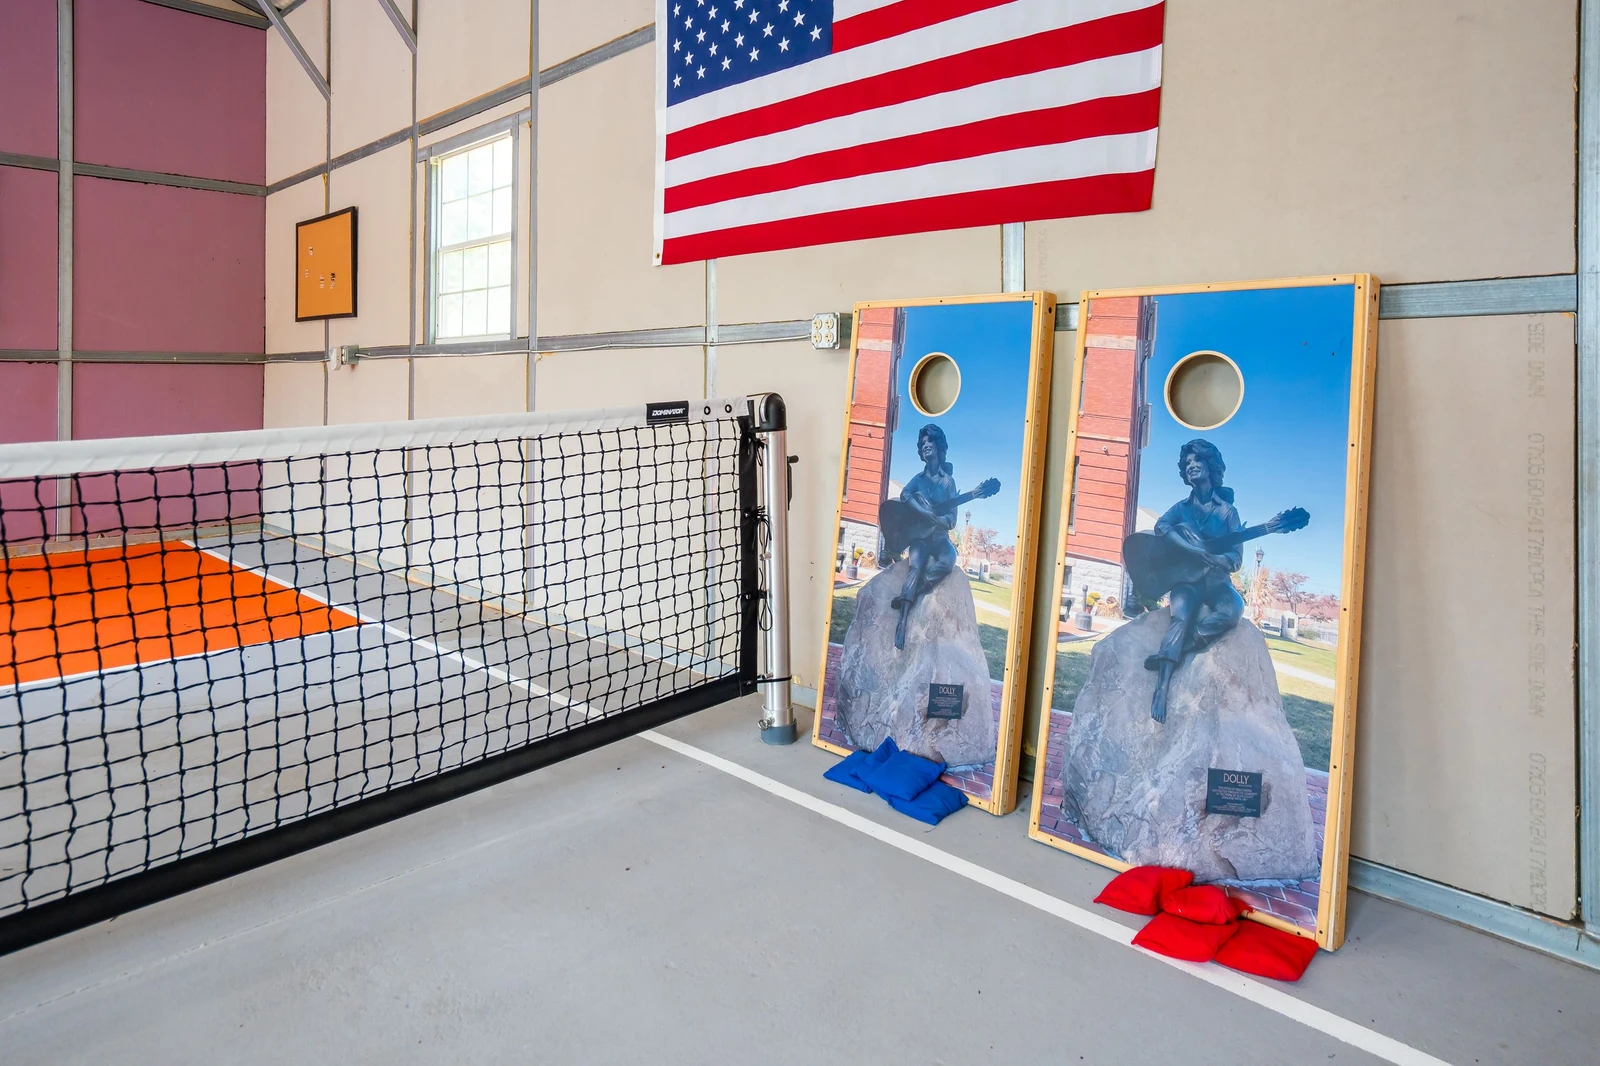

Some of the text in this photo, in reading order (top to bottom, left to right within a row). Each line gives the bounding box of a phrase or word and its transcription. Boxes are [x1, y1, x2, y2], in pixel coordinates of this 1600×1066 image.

[1528, 323, 1545, 354] SIDE
[1528, 360, 1546, 398] DOWN
[652, 408, 685, 416] DOMINATOR
[1528, 605, 1545, 637] THIS
[1528, 643, 1545, 675] SIDE
[939, 686, 956, 695] DOLLY
[1528, 678, 1545, 719] DOWN
[1223, 773, 1250, 785] DOLLY
